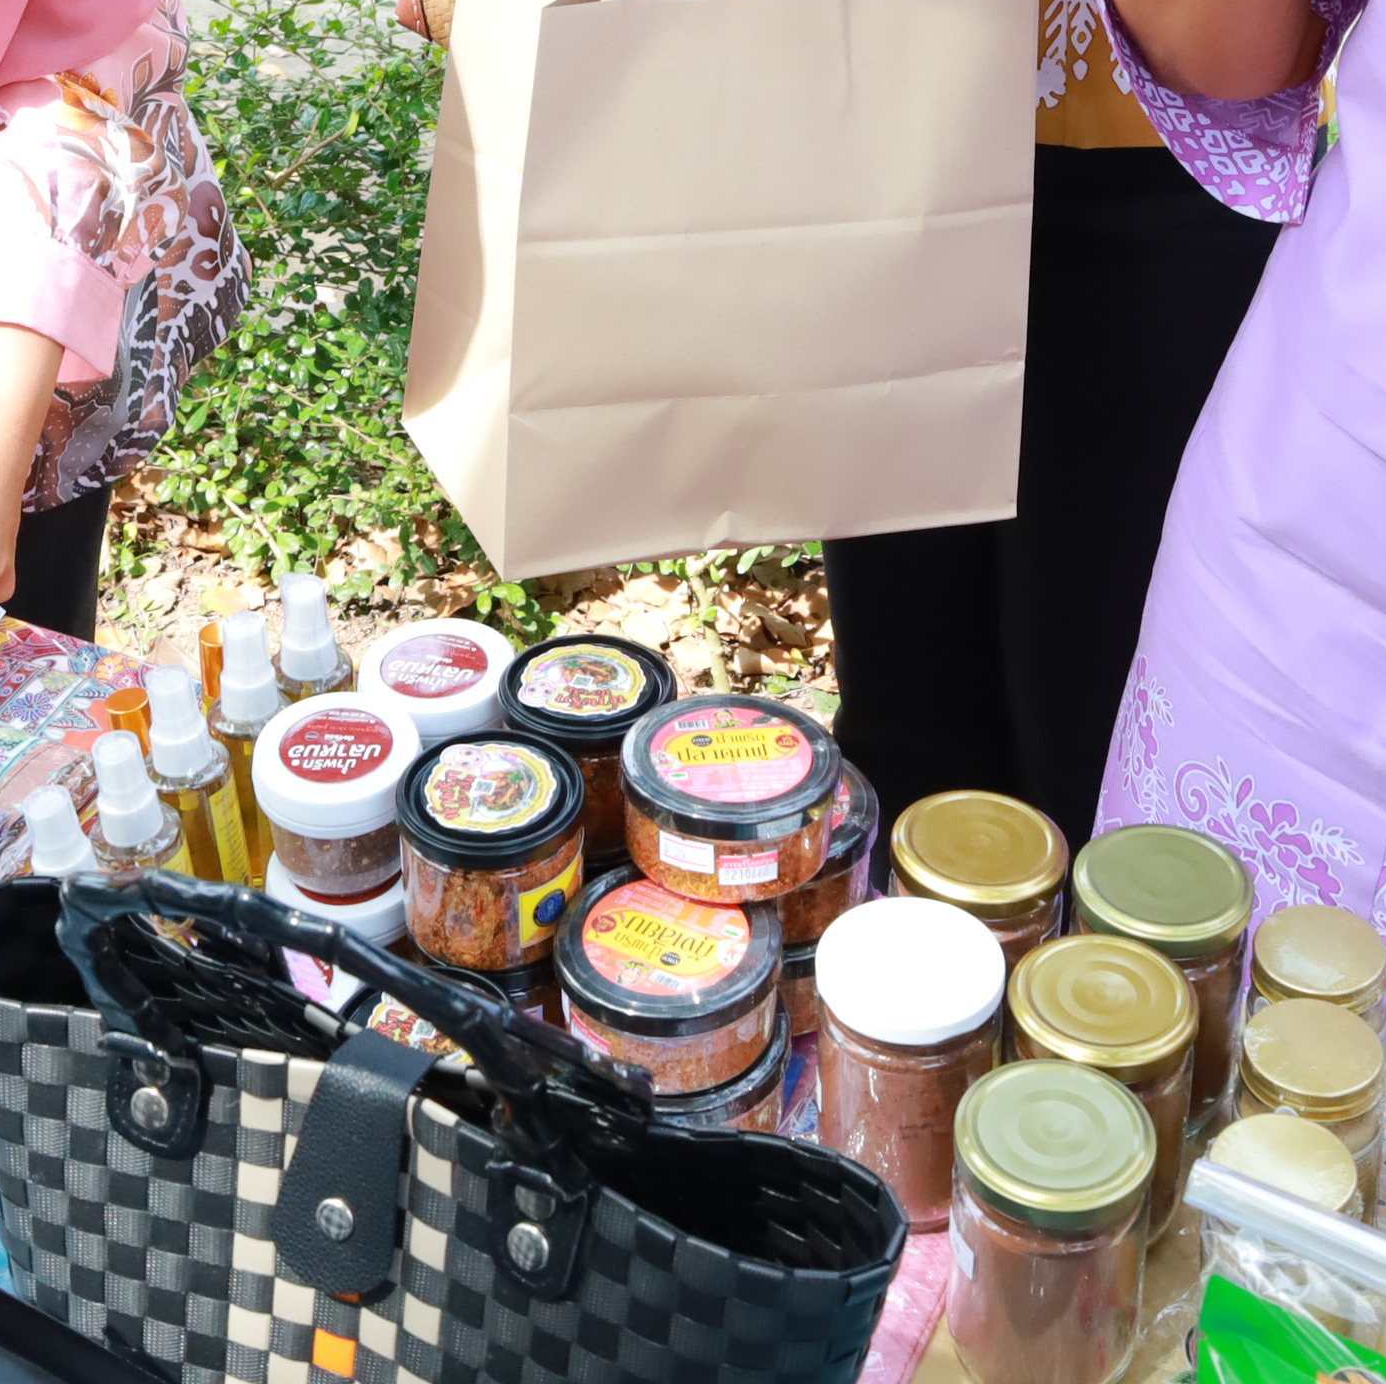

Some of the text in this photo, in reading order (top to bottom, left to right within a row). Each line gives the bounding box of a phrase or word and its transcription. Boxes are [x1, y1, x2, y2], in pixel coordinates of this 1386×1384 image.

[302, 758, 357, 774] น้ำพริก
[623, 916, 714, 962] กุ้งเสียบ
